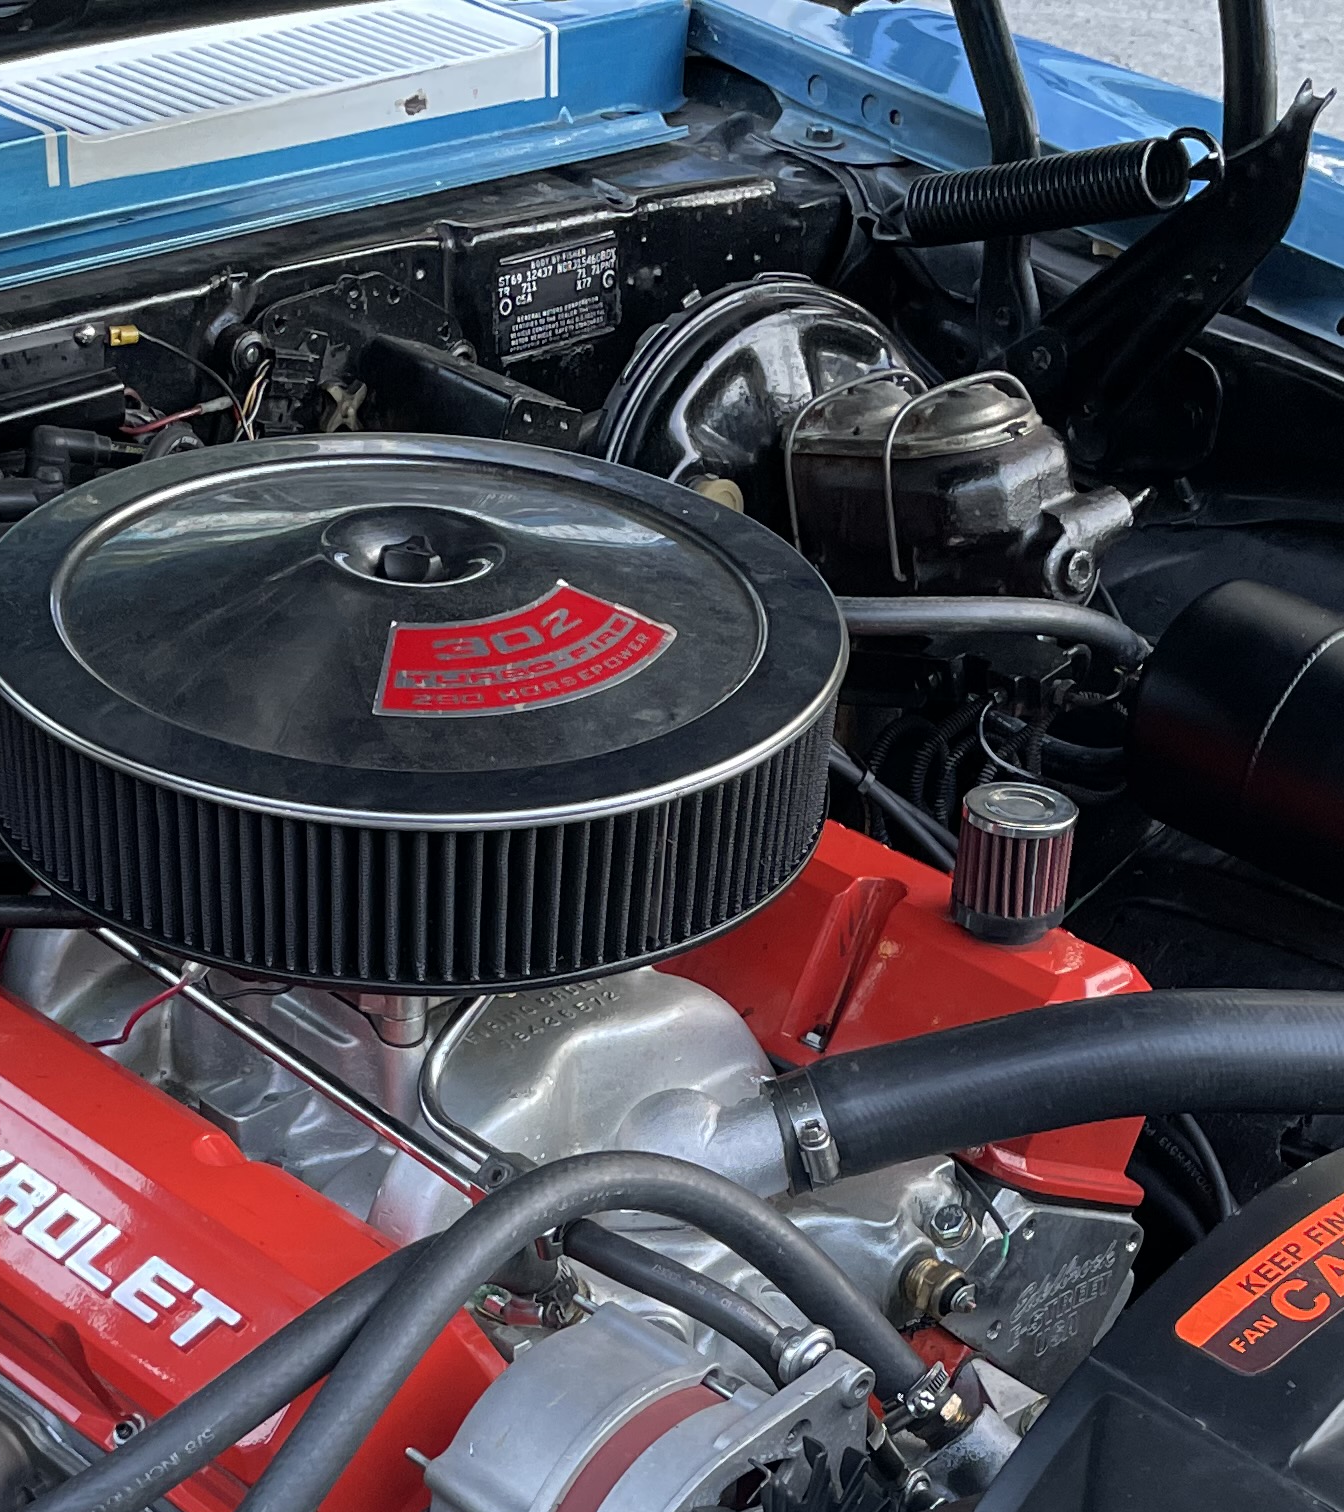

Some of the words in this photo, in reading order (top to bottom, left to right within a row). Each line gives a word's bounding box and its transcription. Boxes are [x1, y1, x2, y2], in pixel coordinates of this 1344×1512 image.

[498, 287, 510, 298] TR
[521, 281, 537, 293] 711
[577, 268, 586, 279] 71
[499, 273, 522, 287] ST69
[527, 266, 552, 281] 12437
[576, 278, 591, 290] X77
[432, 608, 582, 660] 302
[499, 633, 650, 701] HORSEPOWER
[1238, 1241, 1304, 1296] KEEP
[1229, 1314, 1278, 1354] FAN
[185, 1429, 215, 1454] 5/8
